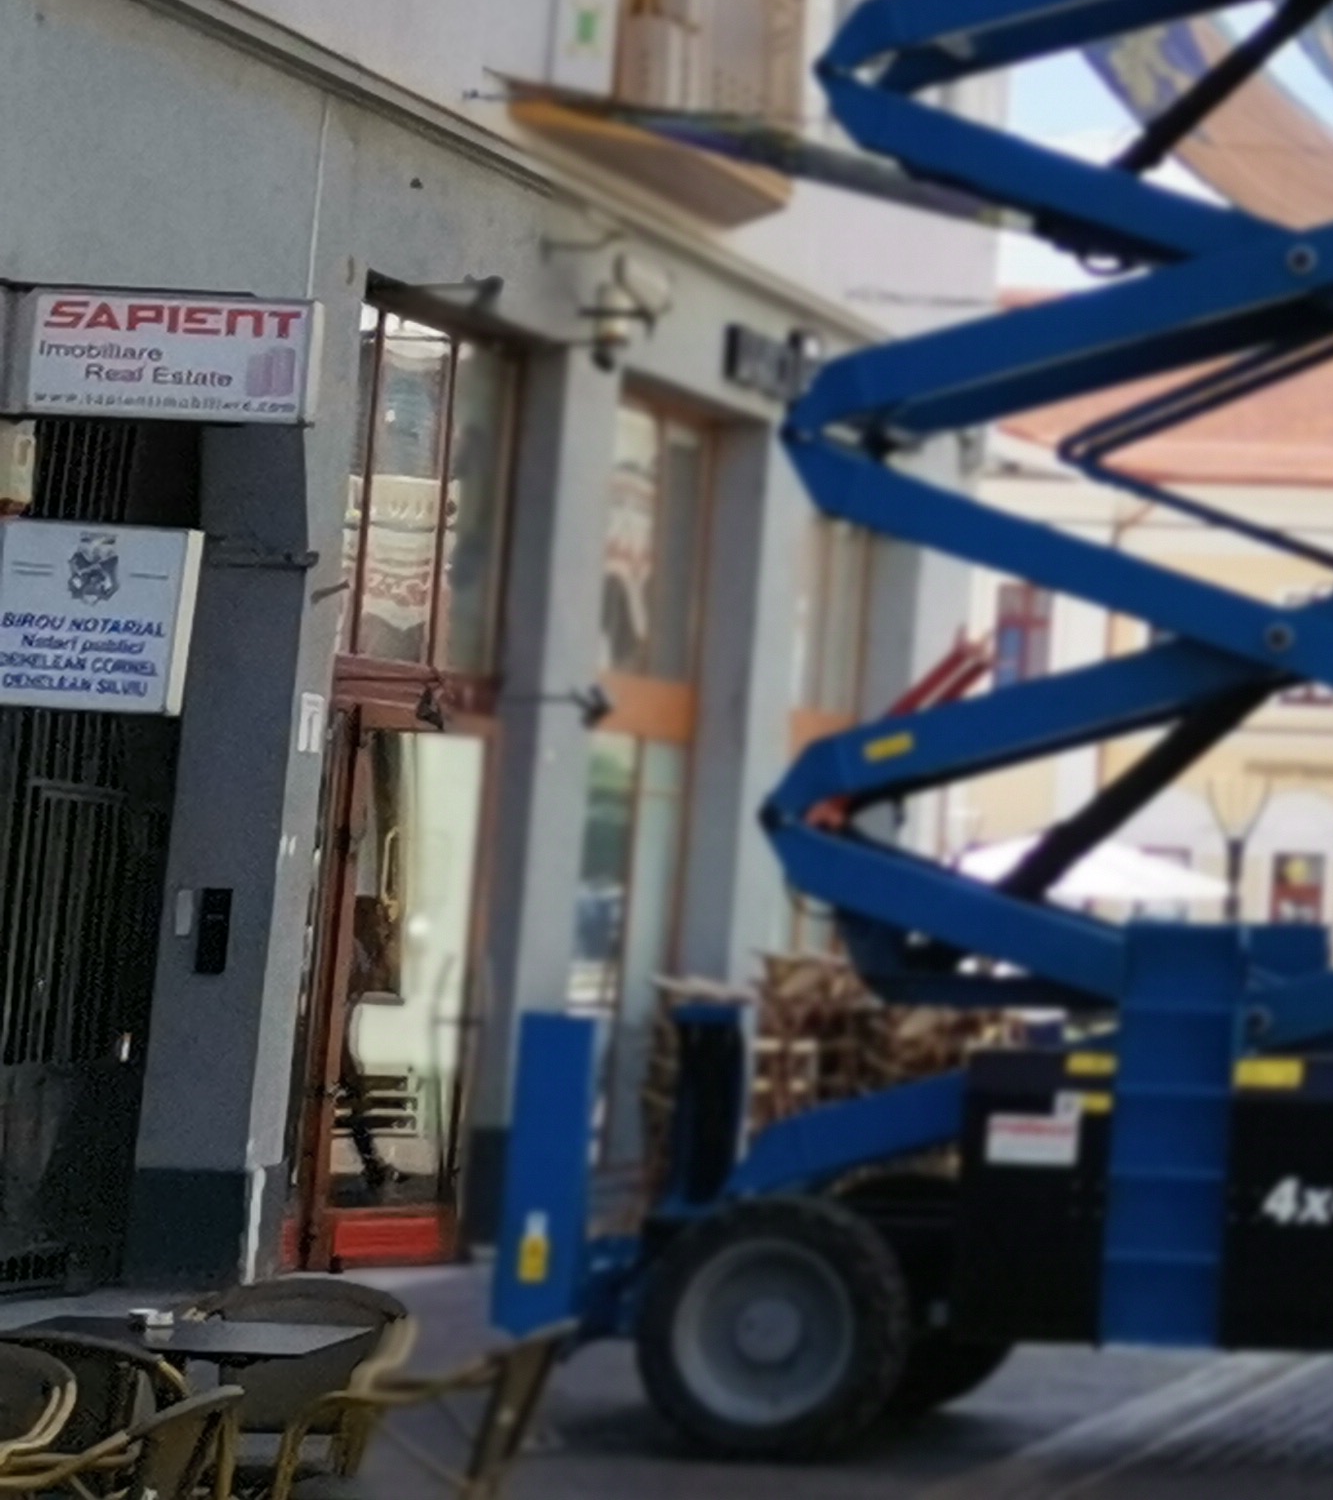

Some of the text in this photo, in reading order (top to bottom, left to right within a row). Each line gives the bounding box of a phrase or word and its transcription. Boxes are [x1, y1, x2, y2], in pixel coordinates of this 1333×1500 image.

[44, 301, 300, 339] SAPIENT
[39, 340, 163, 362] Imobiliare
[84, 363, 233, 388] Real Estate
[0, 612, 165, 637] BIROU NOTARIAL
